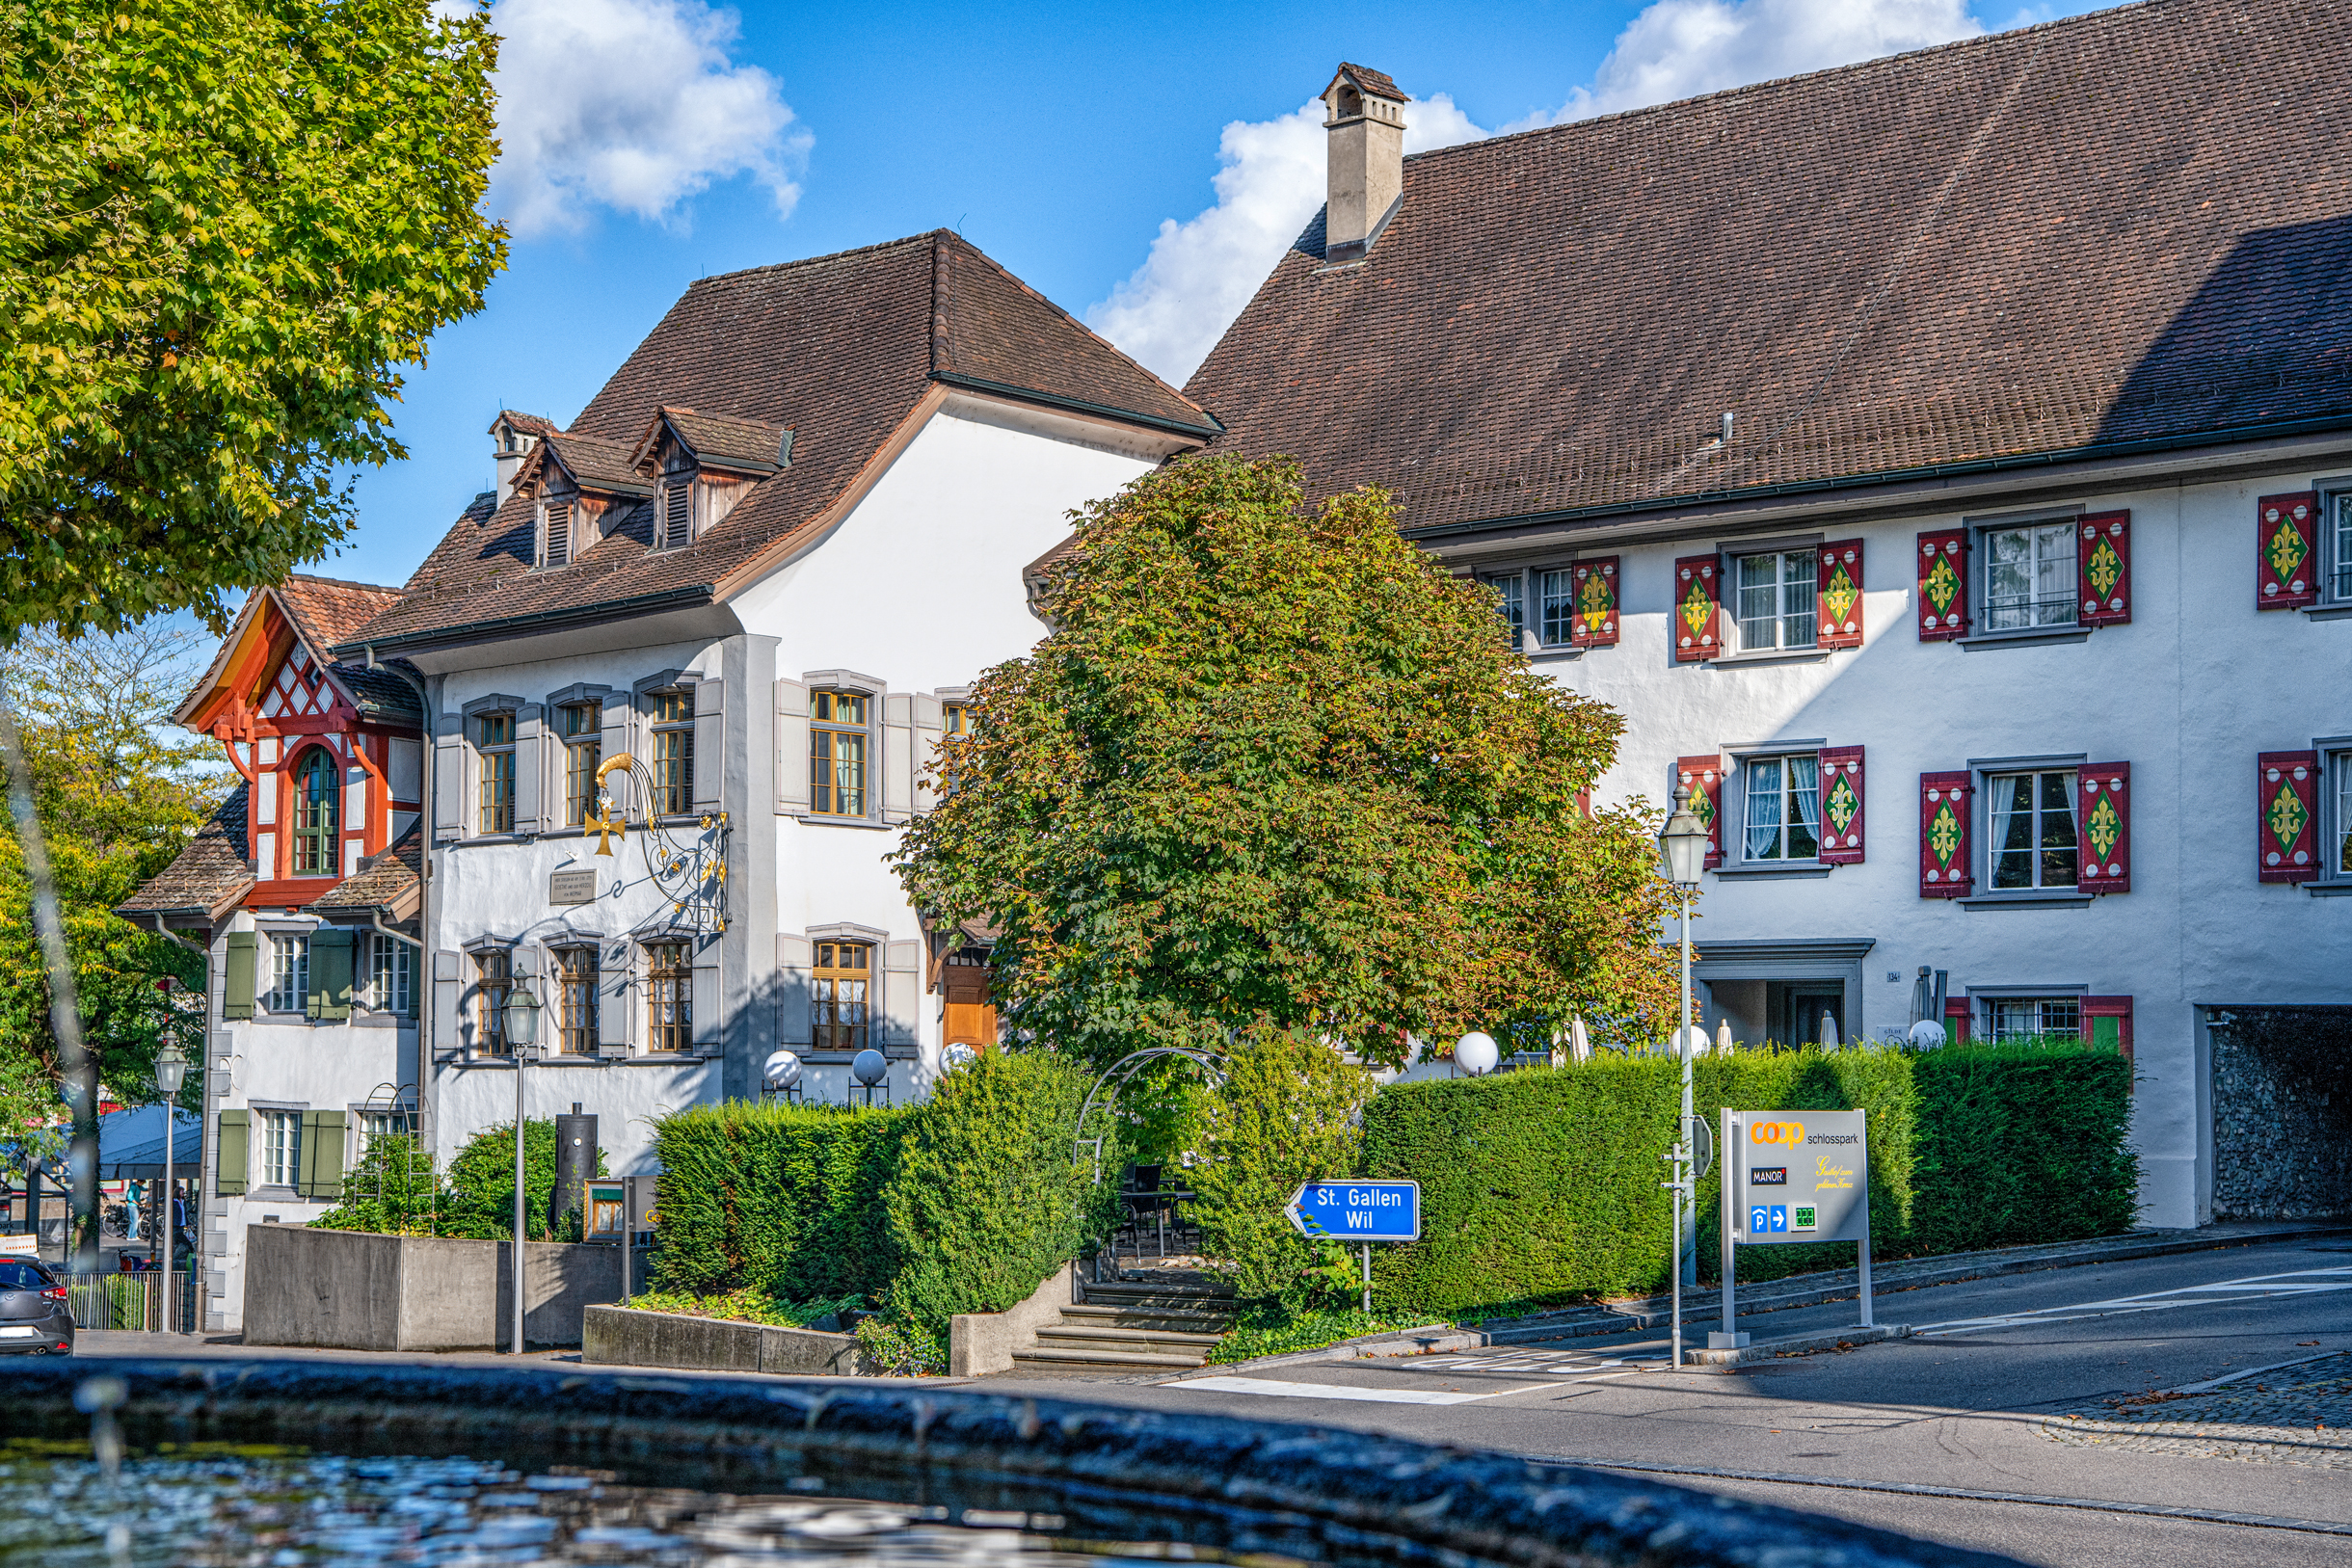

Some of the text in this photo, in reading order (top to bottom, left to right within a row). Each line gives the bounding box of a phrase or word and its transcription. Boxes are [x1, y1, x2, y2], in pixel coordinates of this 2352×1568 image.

[1888, 972, 1898, 981] 134
[1751, 1121, 1858, 1151] coop schlosspark
[1752, 1171, 1783, 1183] MANOR
[1317, 1187, 1402, 1207] St. Gallen
[1346, 1210, 1373, 1229] Wil
[1796, 1209, 1814, 1226] 223
